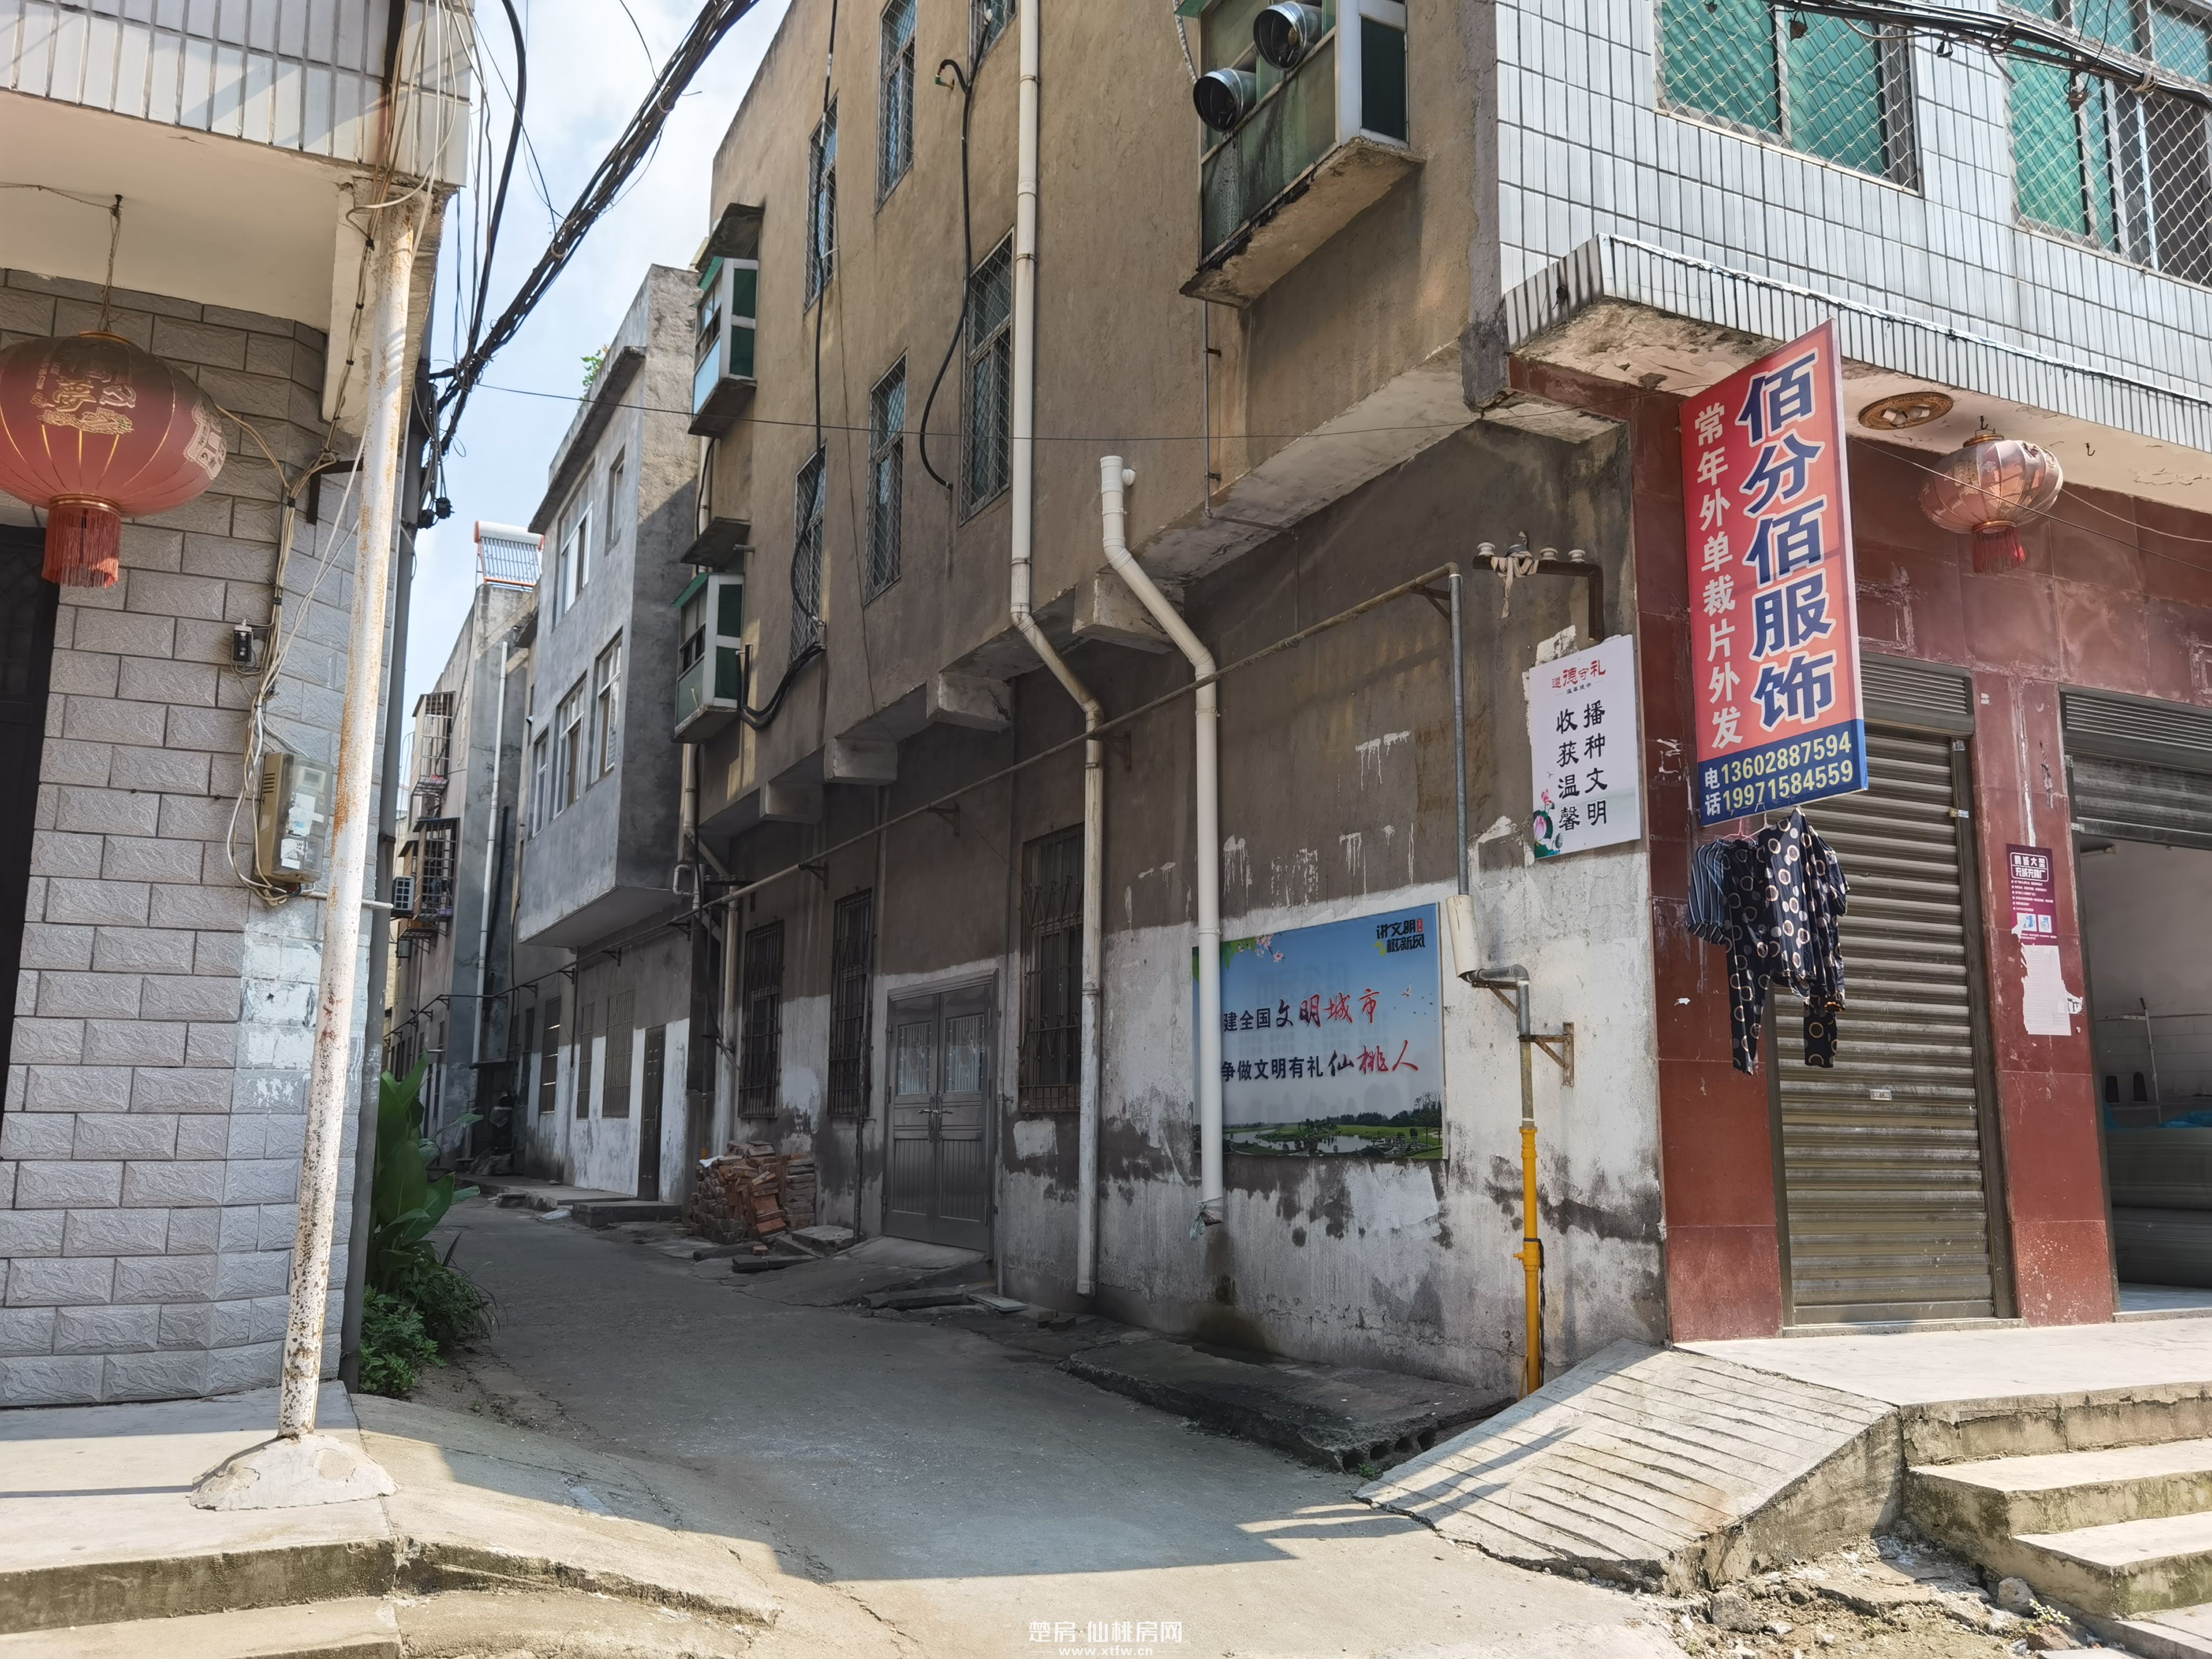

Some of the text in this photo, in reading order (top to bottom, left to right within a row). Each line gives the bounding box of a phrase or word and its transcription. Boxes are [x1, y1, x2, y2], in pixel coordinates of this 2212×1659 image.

[1735, 347, 1836, 731] 佰分佰服饰
[1695, 402, 1743, 749] 常年外单裁片外发
[1556, 709, 1580, 832] 收获温馨
[1583, 700, 1608, 826] 播种文明
[1721, 731, 1851, 785] 13602887594
[1704, 768, 1721, 816] 电话
[1723, 760, 1853, 811] 19971584559
[1376, 919, 1415, 939] 讲文明
[1386, 934, 1425, 953] 树新风
[1220, 1040, 1419, 1082] 争做文明有礼仙桃人
